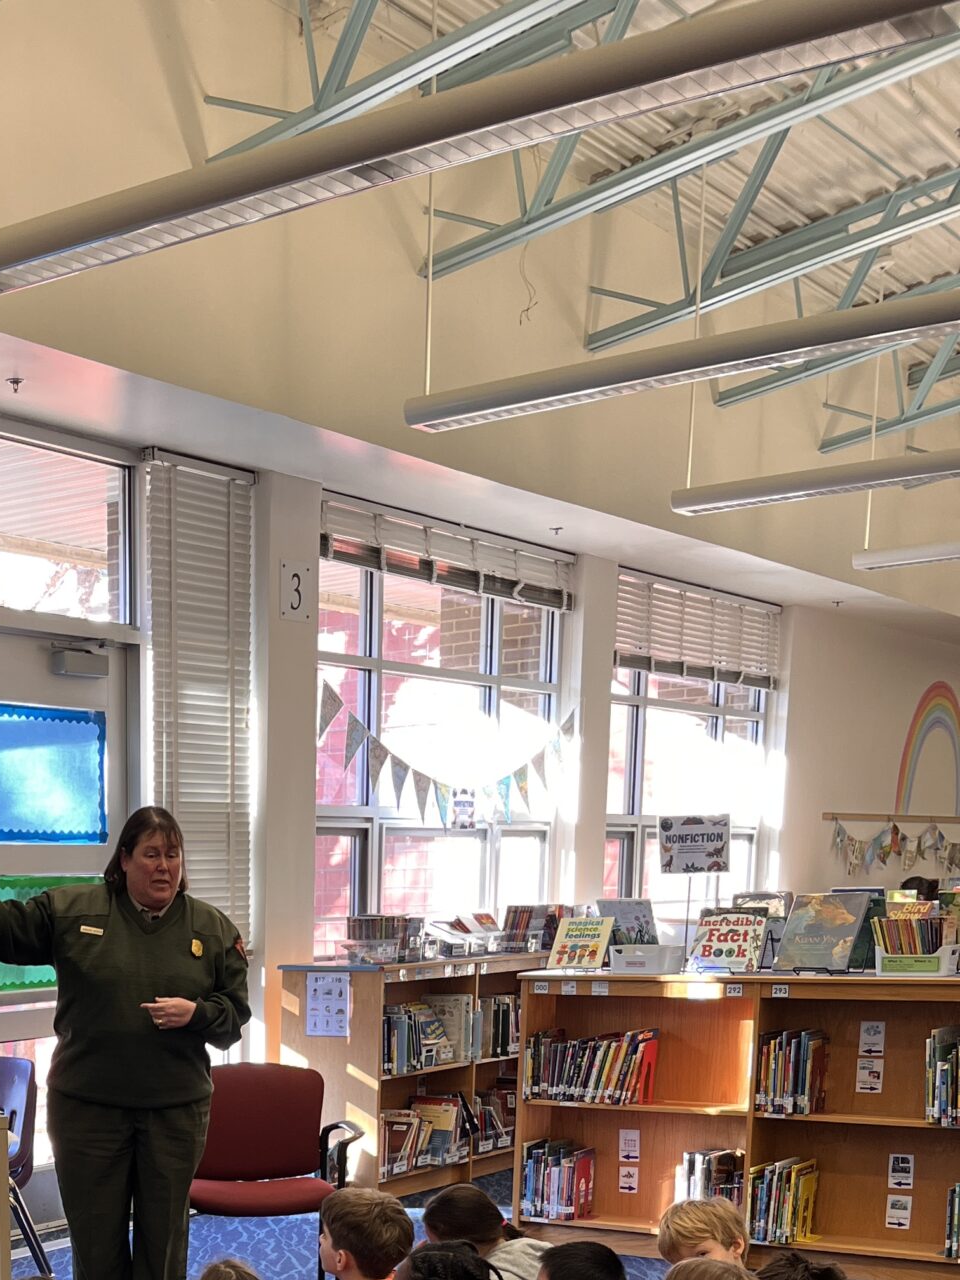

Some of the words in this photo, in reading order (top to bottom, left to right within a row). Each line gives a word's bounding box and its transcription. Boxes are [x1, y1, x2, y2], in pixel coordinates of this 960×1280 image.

[290, 572, 302, 611] 3
[665, 831, 724, 845] NONFICTION
[902, 902, 932, 913] Bird
[568, 919, 604, 927] magical
[699, 917, 764, 927] Incredible
[564, 932, 601, 940] feelings
[706, 928, 749, 943] Fact
[700, 944, 748, 958] Book
[727, 986, 742, 994] 292
[773, 987, 788, 995] 293
